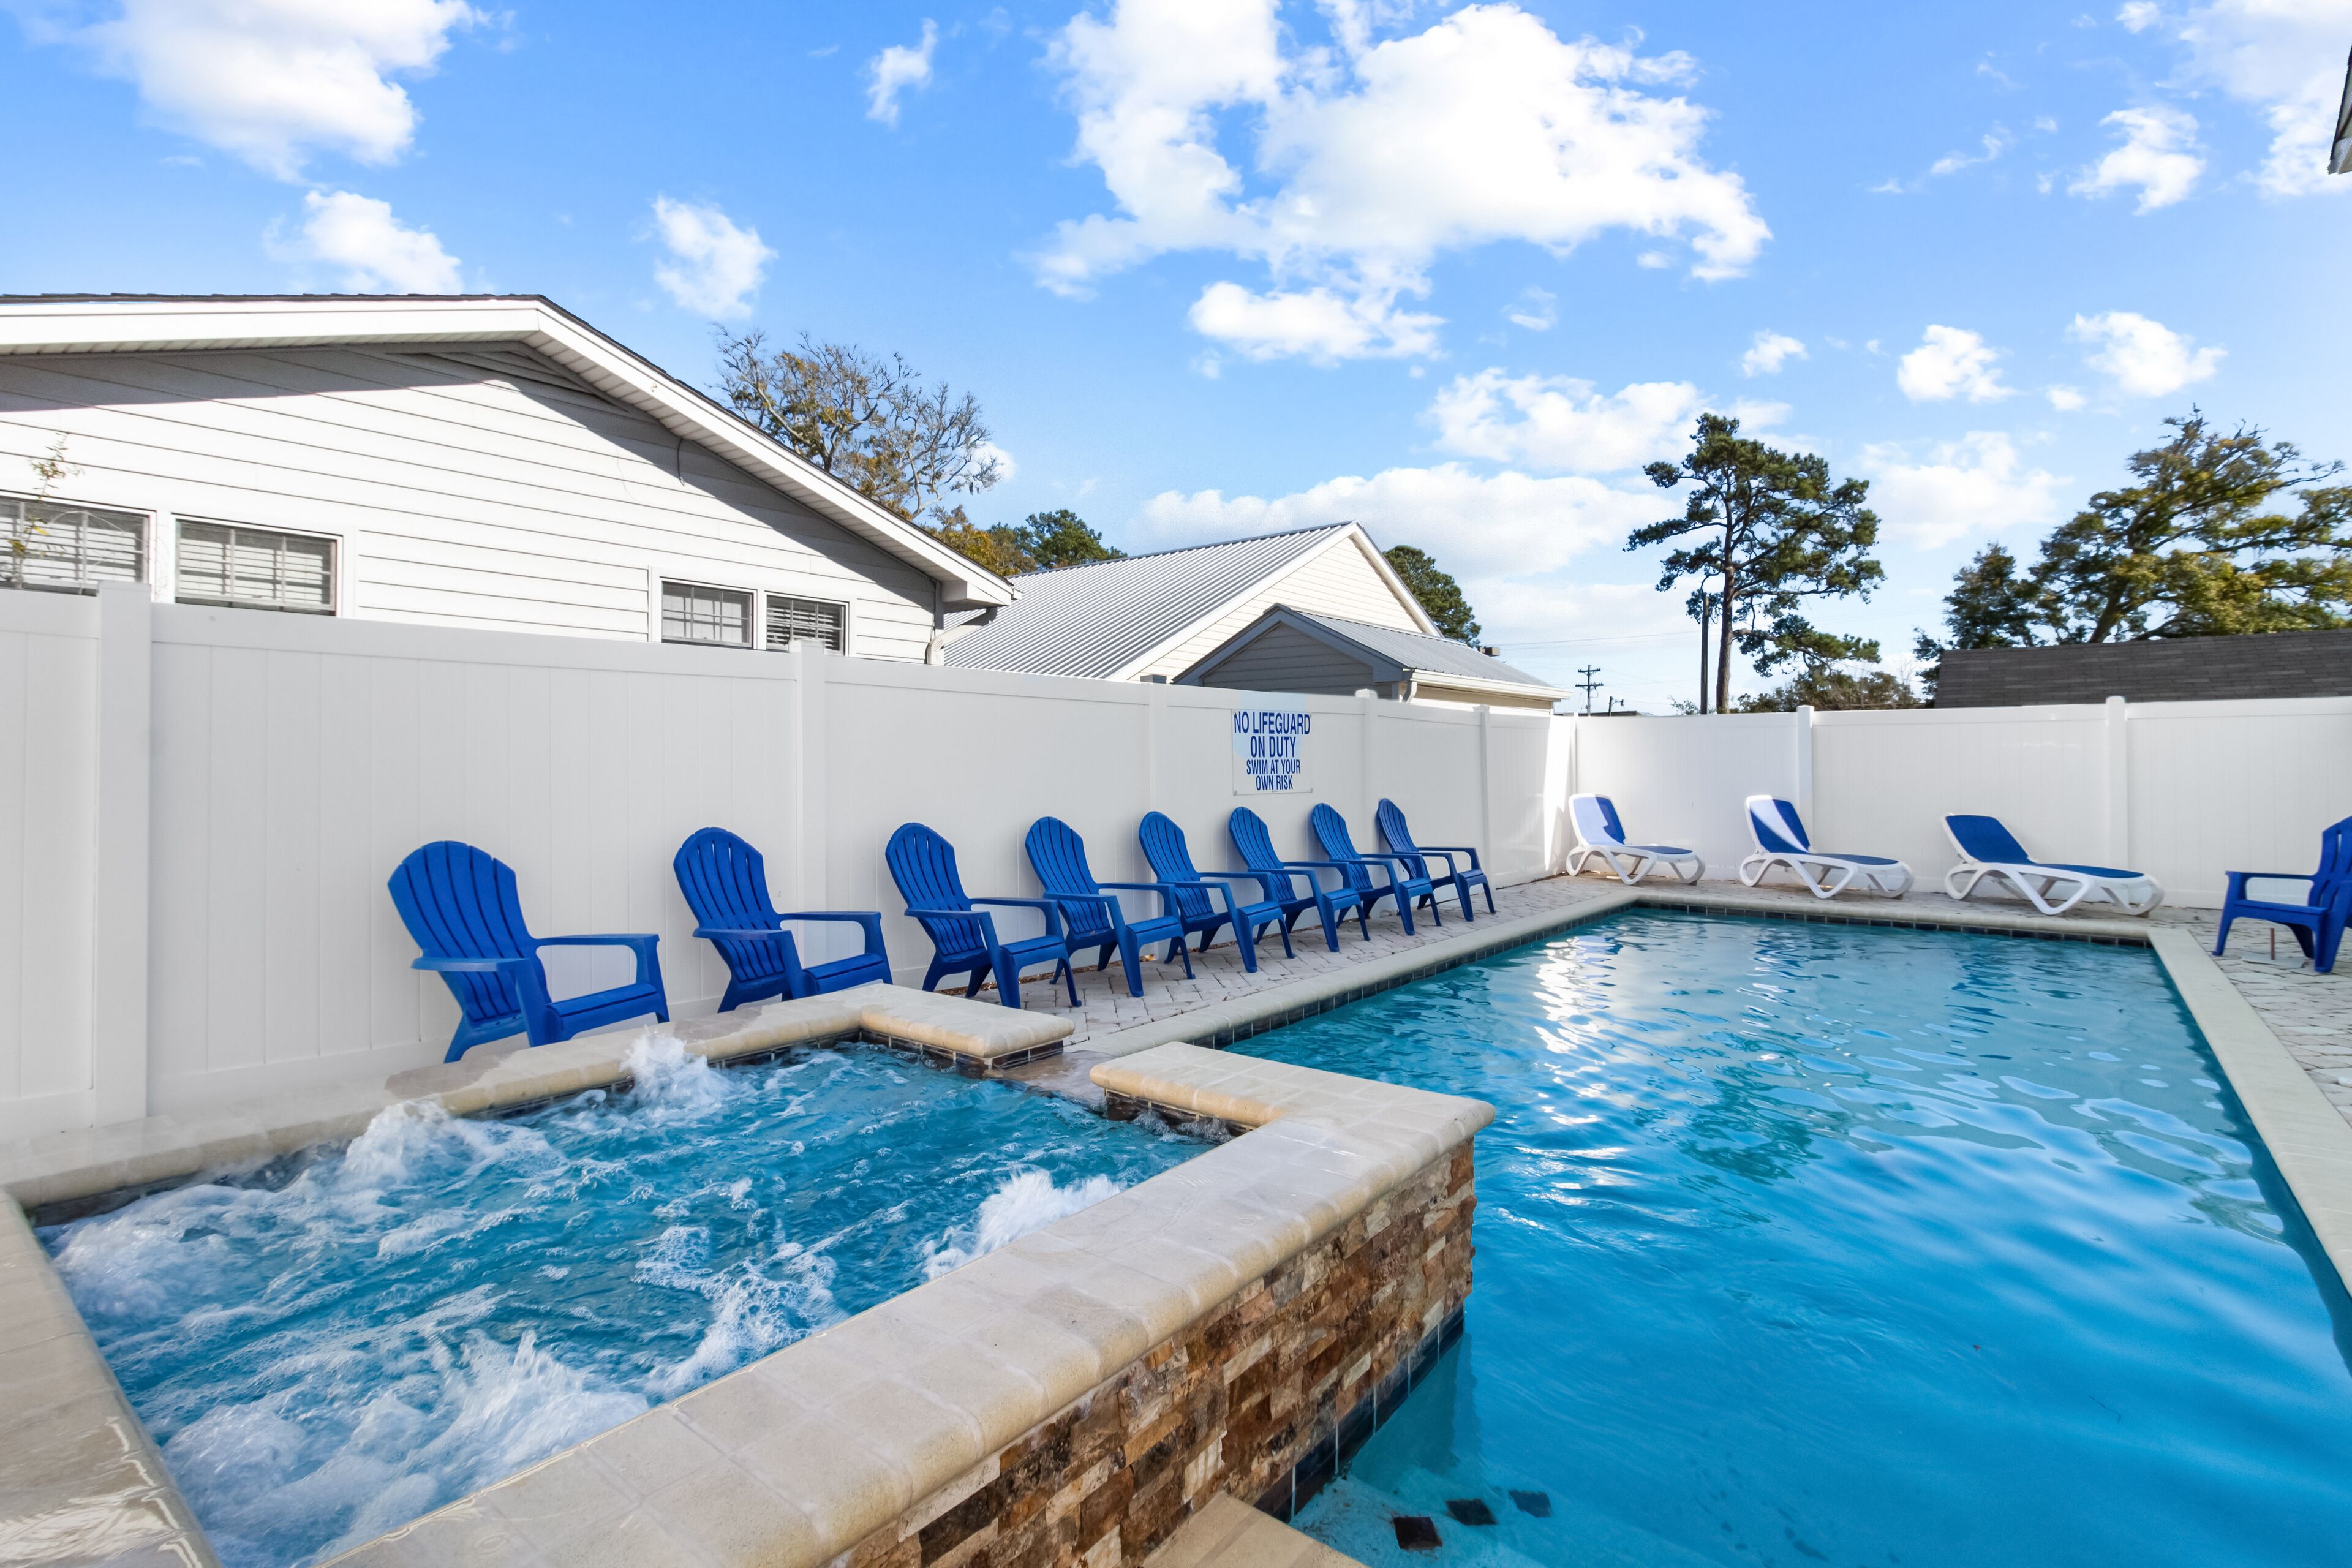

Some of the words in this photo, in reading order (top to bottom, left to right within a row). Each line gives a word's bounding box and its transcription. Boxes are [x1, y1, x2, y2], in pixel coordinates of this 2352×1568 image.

[1234, 711, 1250, 733] NO
[1253, 712, 1311, 734] LIFEGUARD
[1250, 736, 1265, 758] ON
[1269, 736, 1296, 758] DUTY
[1246, 760, 1268, 775] SWIM
[1270, 760, 1279, 774] AT
[1281, 760, 1301, 774] YOUR
[1256, 775, 1274, 791] OWN
[1276, 775, 1293, 790] RISK
